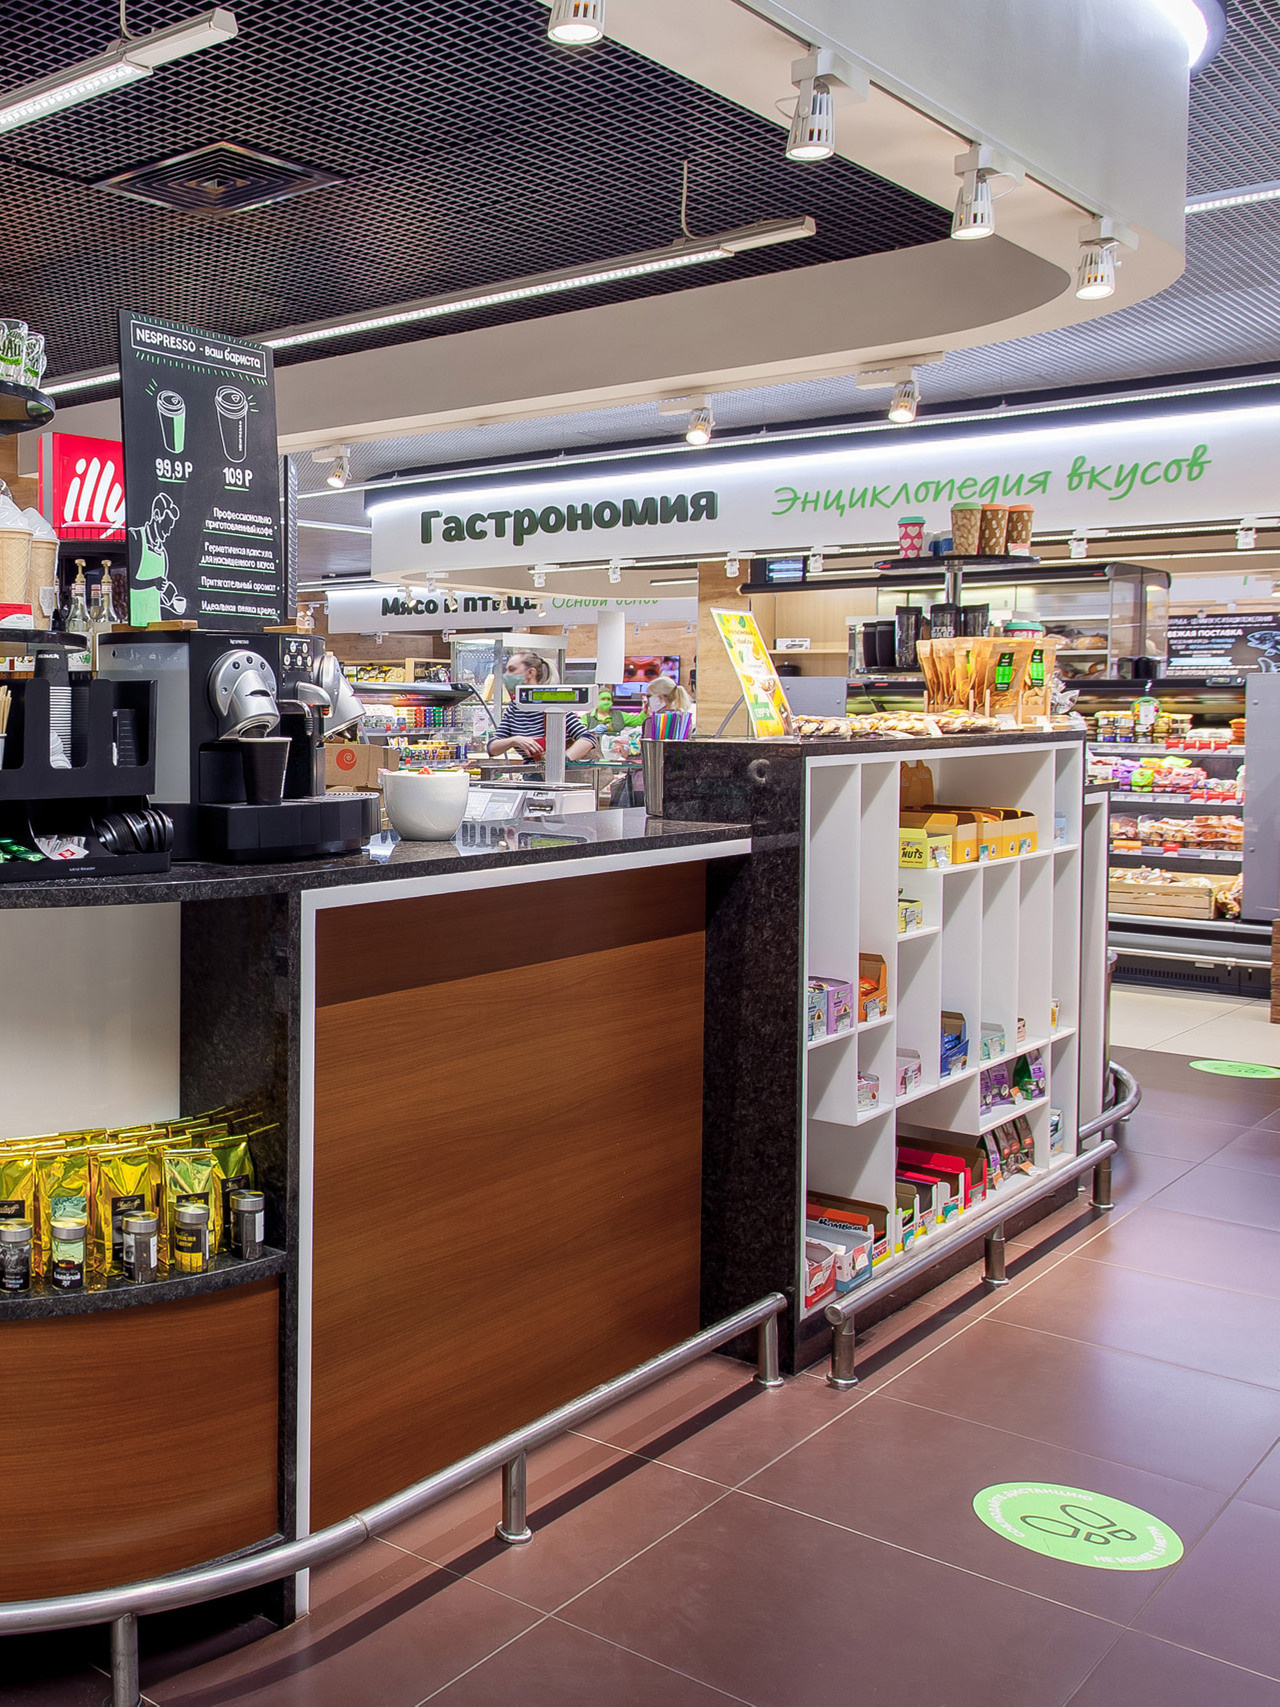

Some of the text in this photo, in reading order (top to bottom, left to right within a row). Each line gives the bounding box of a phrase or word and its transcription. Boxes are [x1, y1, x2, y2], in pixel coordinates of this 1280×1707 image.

[136, 327, 196, 353] NESPRESSO
[205, 346, 224, 360] ваш
[224, 347, 261, 369] бариста
[155, 458, 193, 479] 99,9 Р
[222, 466, 253, 487] 109 Р
[771, 443, 1213, 518] Энциклопедия вкусов
[64, 457, 126, 539] illy
[421, 490, 719, 547] Гастрономия
[901, 850, 923, 859] NUTS
